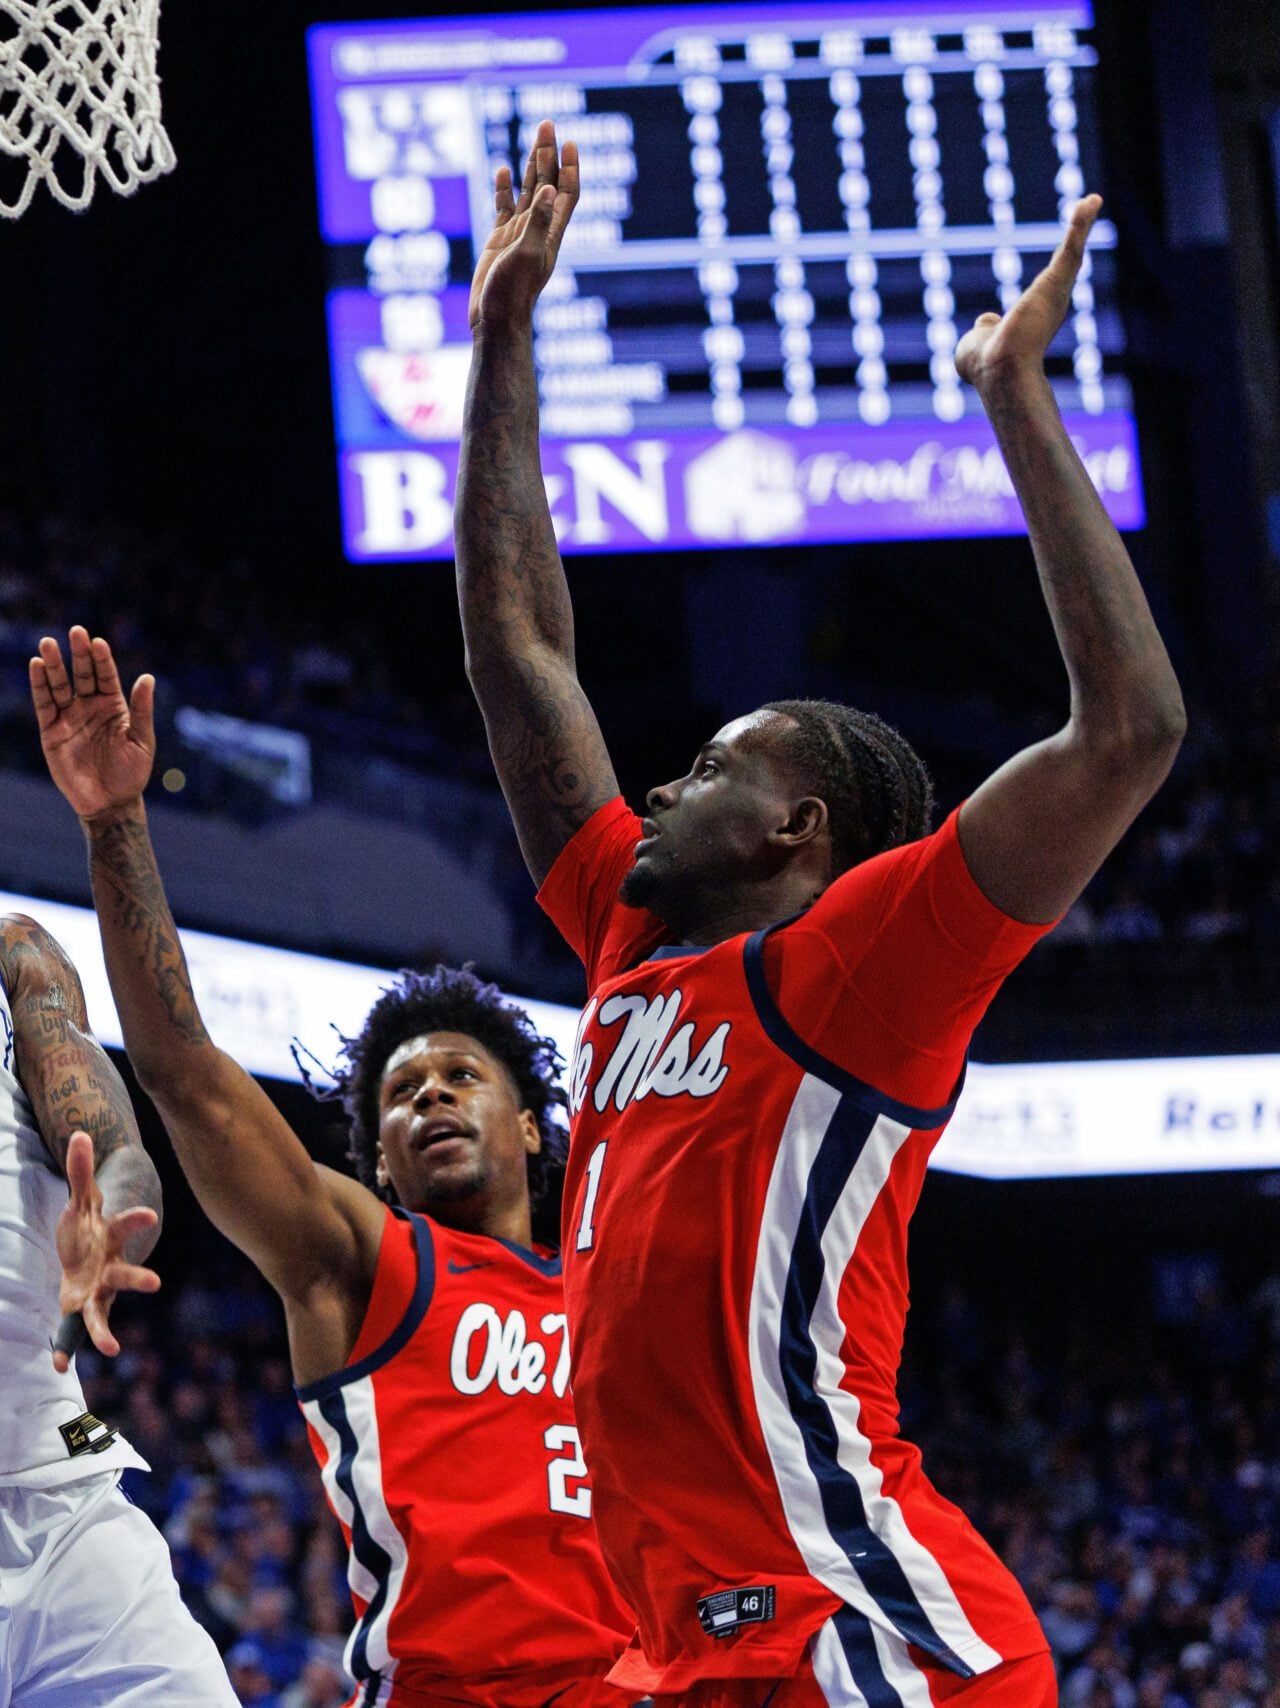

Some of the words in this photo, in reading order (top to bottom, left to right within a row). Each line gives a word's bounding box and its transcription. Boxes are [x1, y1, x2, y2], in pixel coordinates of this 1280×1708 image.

[576, 1139, 608, 1252] 1
[450, 1302, 547, 1397] Ole
[543, 1424, 593, 1519] 2
[741, 1595, 759, 1612] 46
